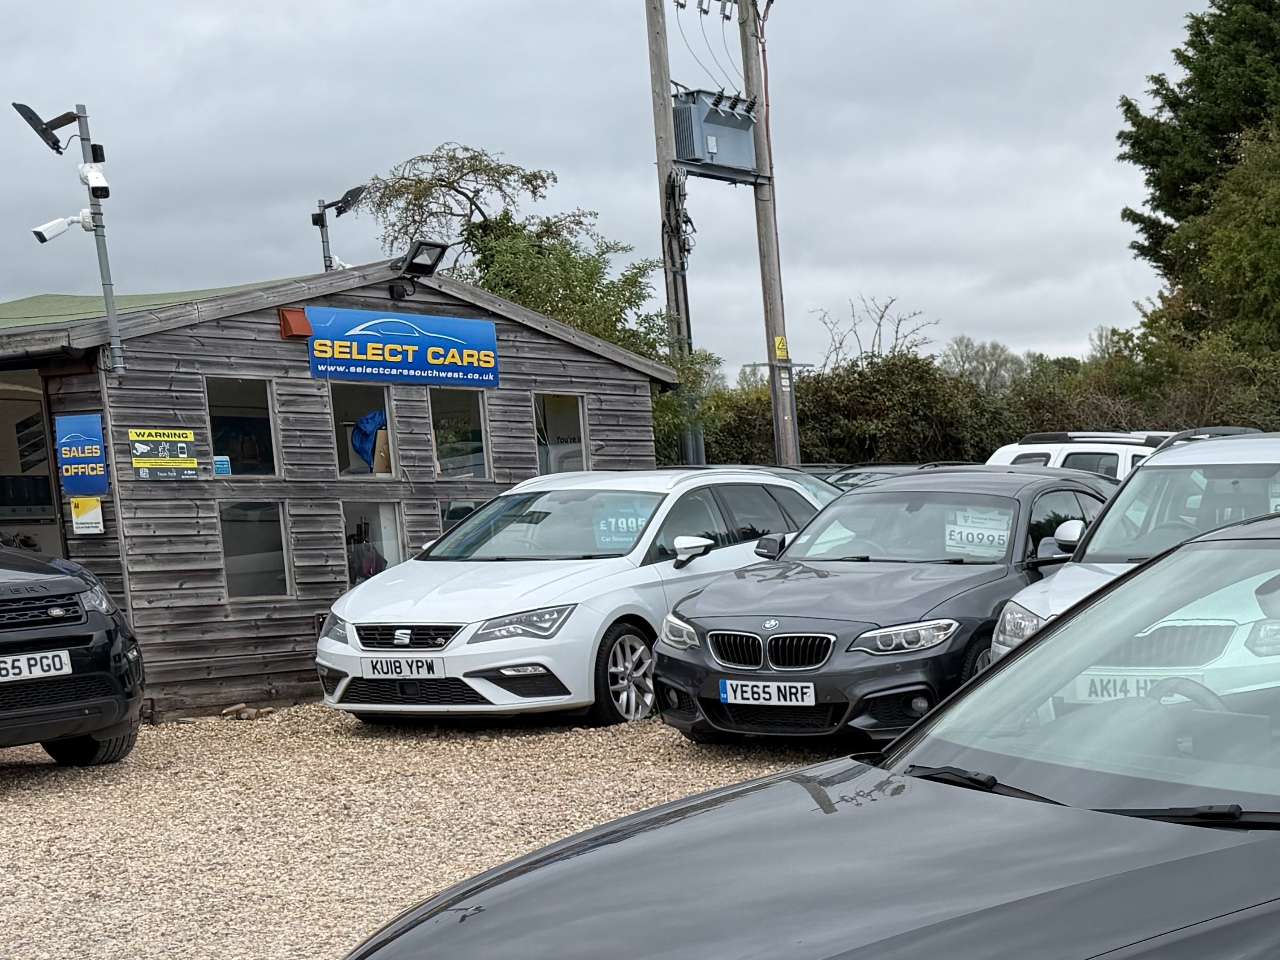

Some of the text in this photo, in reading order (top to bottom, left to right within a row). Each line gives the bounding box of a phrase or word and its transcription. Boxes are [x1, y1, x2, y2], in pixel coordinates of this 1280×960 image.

[313, 339, 496, 369] SELECT CARS
[317, 363, 495, 381] www.selectcarssouthwest.co.uk
[134, 431, 189, 439] WARNING
[61, 445, 101, 459] SALES
[62, 463, 105, 477] OFFICE
[948, 529, 1006, 546] £10995
[26, 654, 64, 675] PGO
[370, 659, 436, 675] KU18 YPW
[729, 683, 811, 703] YE65 NRF
[1087, 678, 1130, 698] AK14
